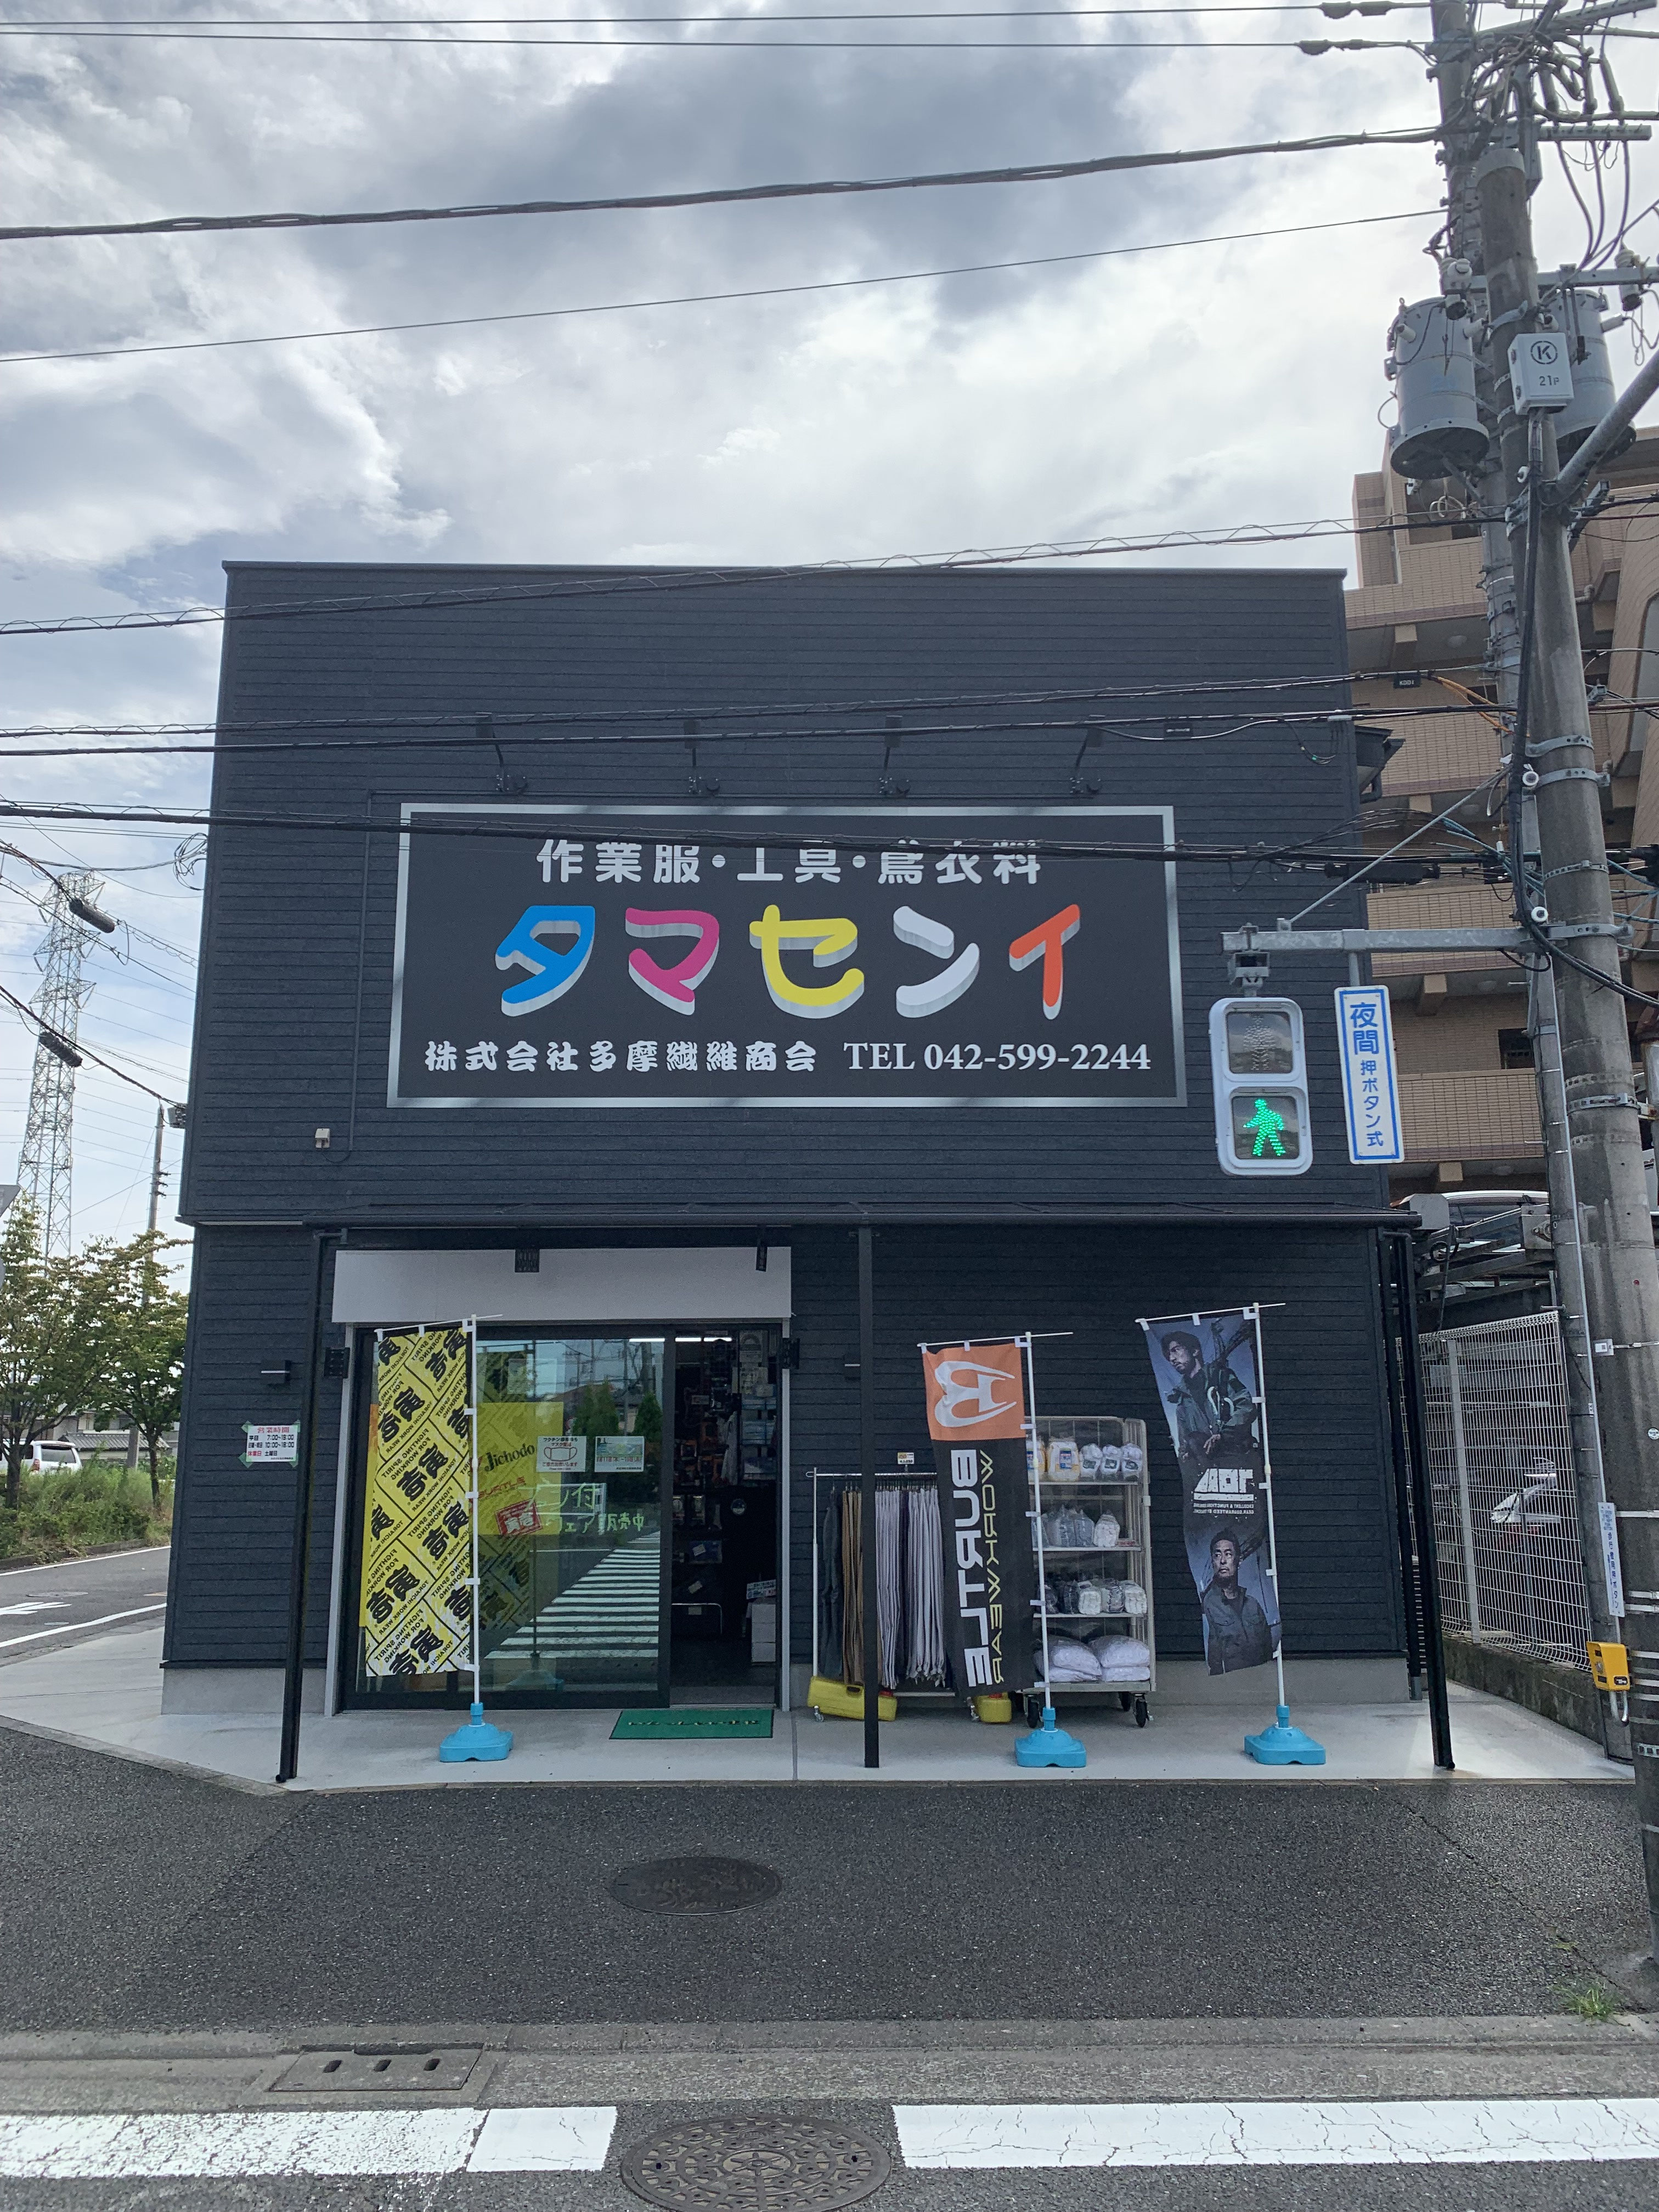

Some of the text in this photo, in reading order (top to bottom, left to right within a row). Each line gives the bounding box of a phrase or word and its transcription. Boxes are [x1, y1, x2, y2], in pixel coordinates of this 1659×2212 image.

[494, 904, 1082, 1020] タマセンイ
[424, 1040, 817, 1073] 株式会社多摩繊維商会
[843, 1042, 1152, 1070] TEL 042-599-2244
[1350, 1001, 1384, 1148] 夜間 押ボタン式
[484, 1443, 535, 1472] Jichodo
